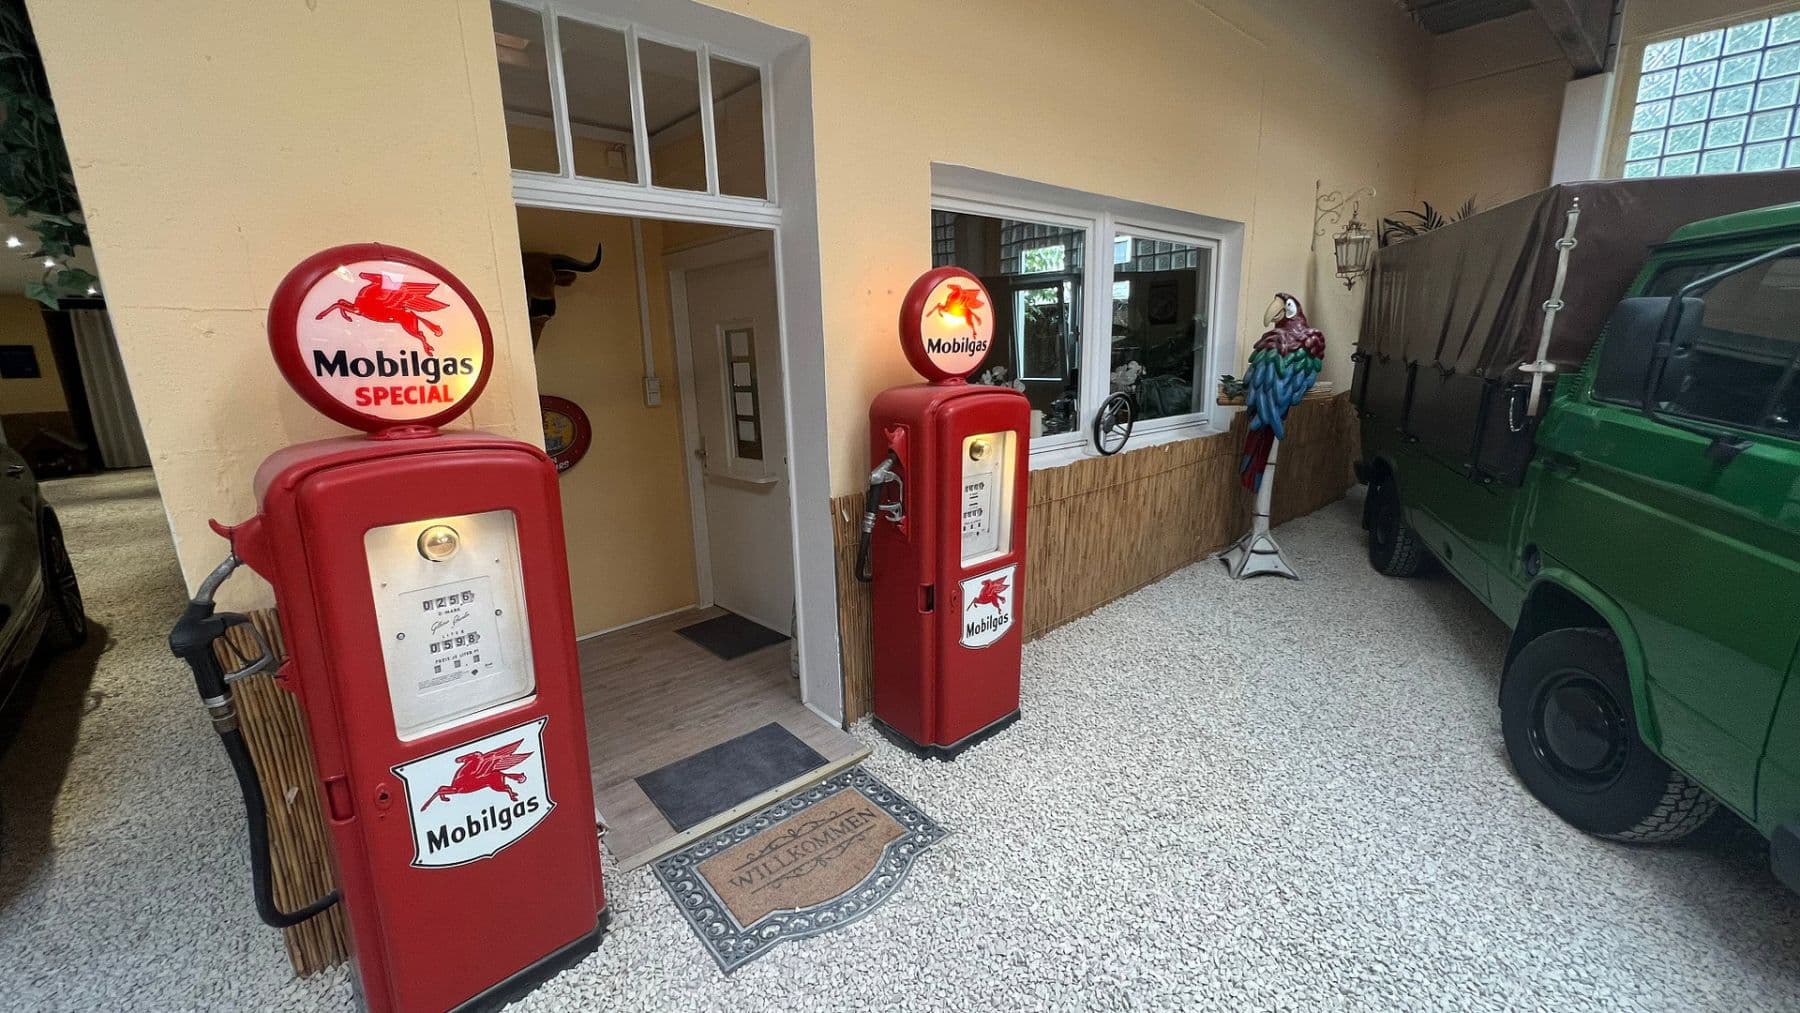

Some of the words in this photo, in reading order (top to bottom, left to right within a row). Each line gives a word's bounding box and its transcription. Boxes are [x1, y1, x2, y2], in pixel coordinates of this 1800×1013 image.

[927, 337, 987, 357] Mobilgas
[313, 350, 473, 384] Mobilgas
[355, 385, 454, 406] SPECIAL
[966, 613, 1009, 638] Mobilgas
[427, 796, 539, 855] Mobilgas
[729, 807, 877, 888] WILLKOMMEN
